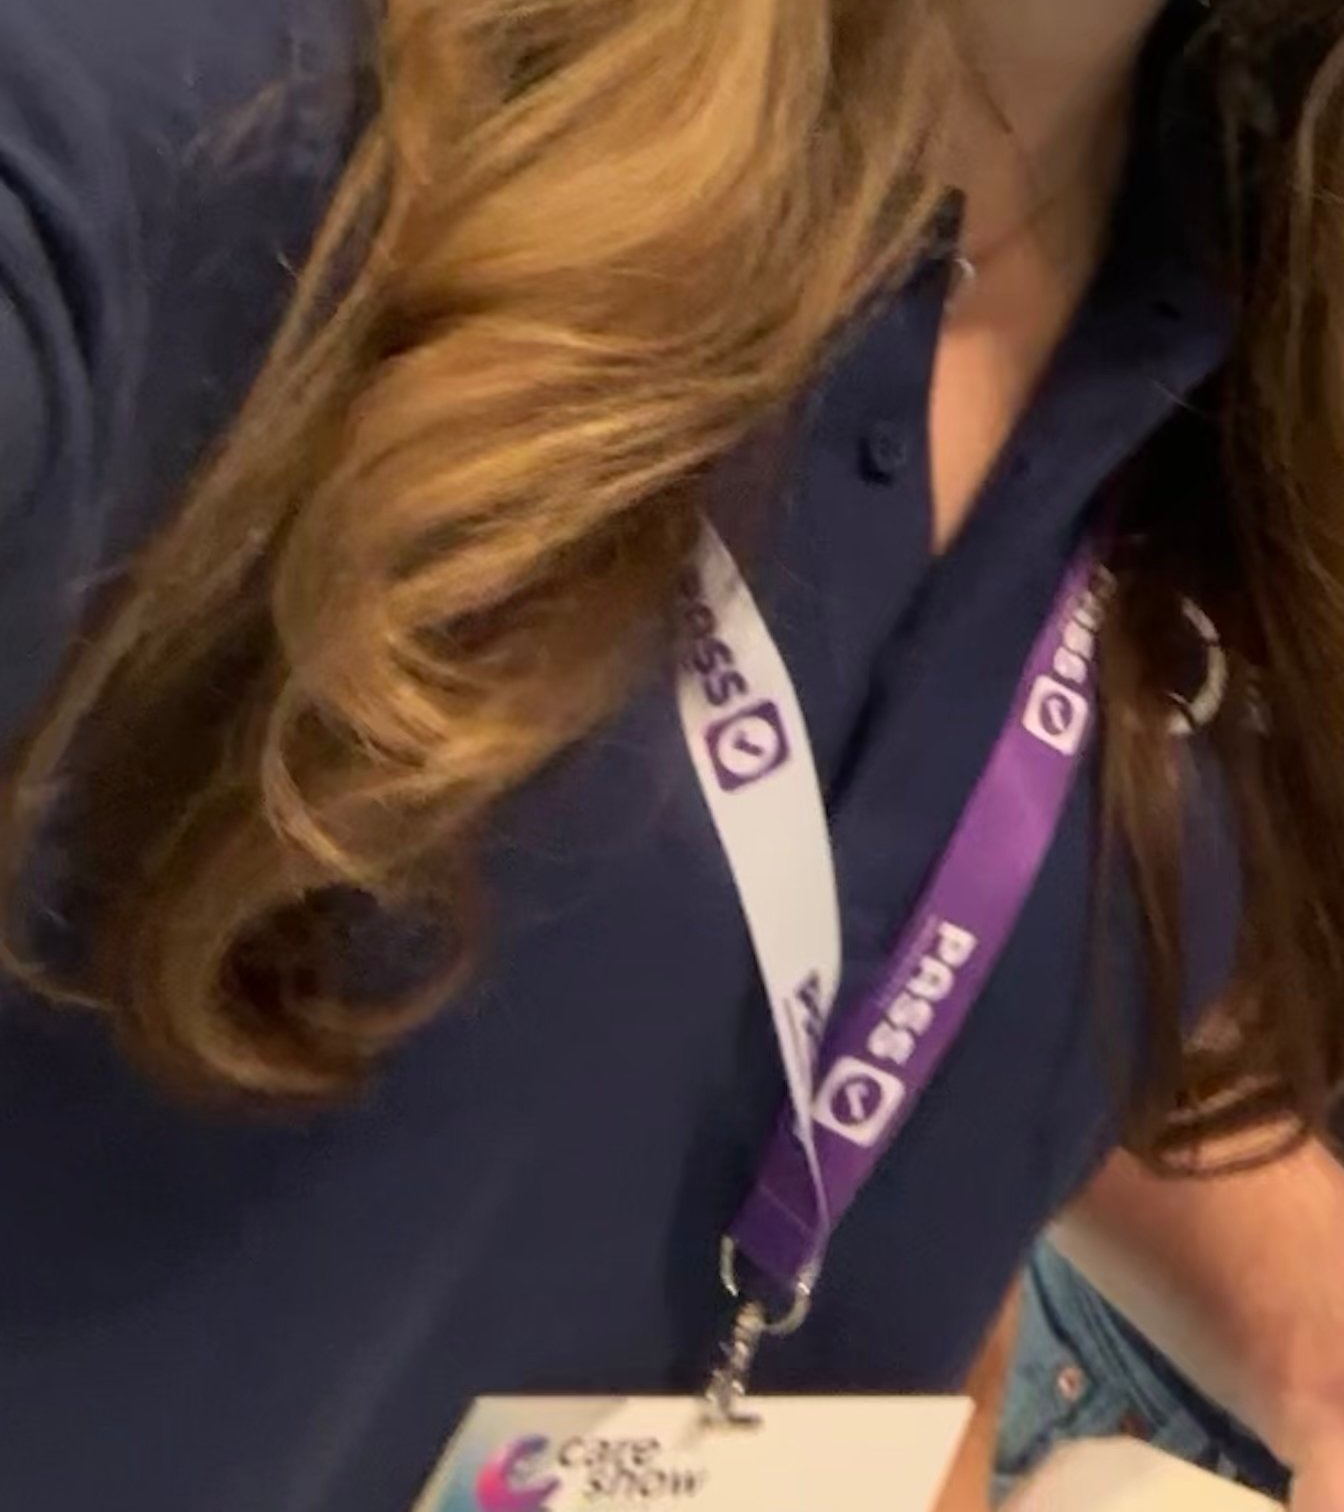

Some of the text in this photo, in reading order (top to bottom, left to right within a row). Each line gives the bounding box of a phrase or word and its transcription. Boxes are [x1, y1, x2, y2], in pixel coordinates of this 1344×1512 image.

[867, 919, 979, 1066] PASS
[557, 1436, 662, 1472] care
[578, 1464, 708, 1501] show
